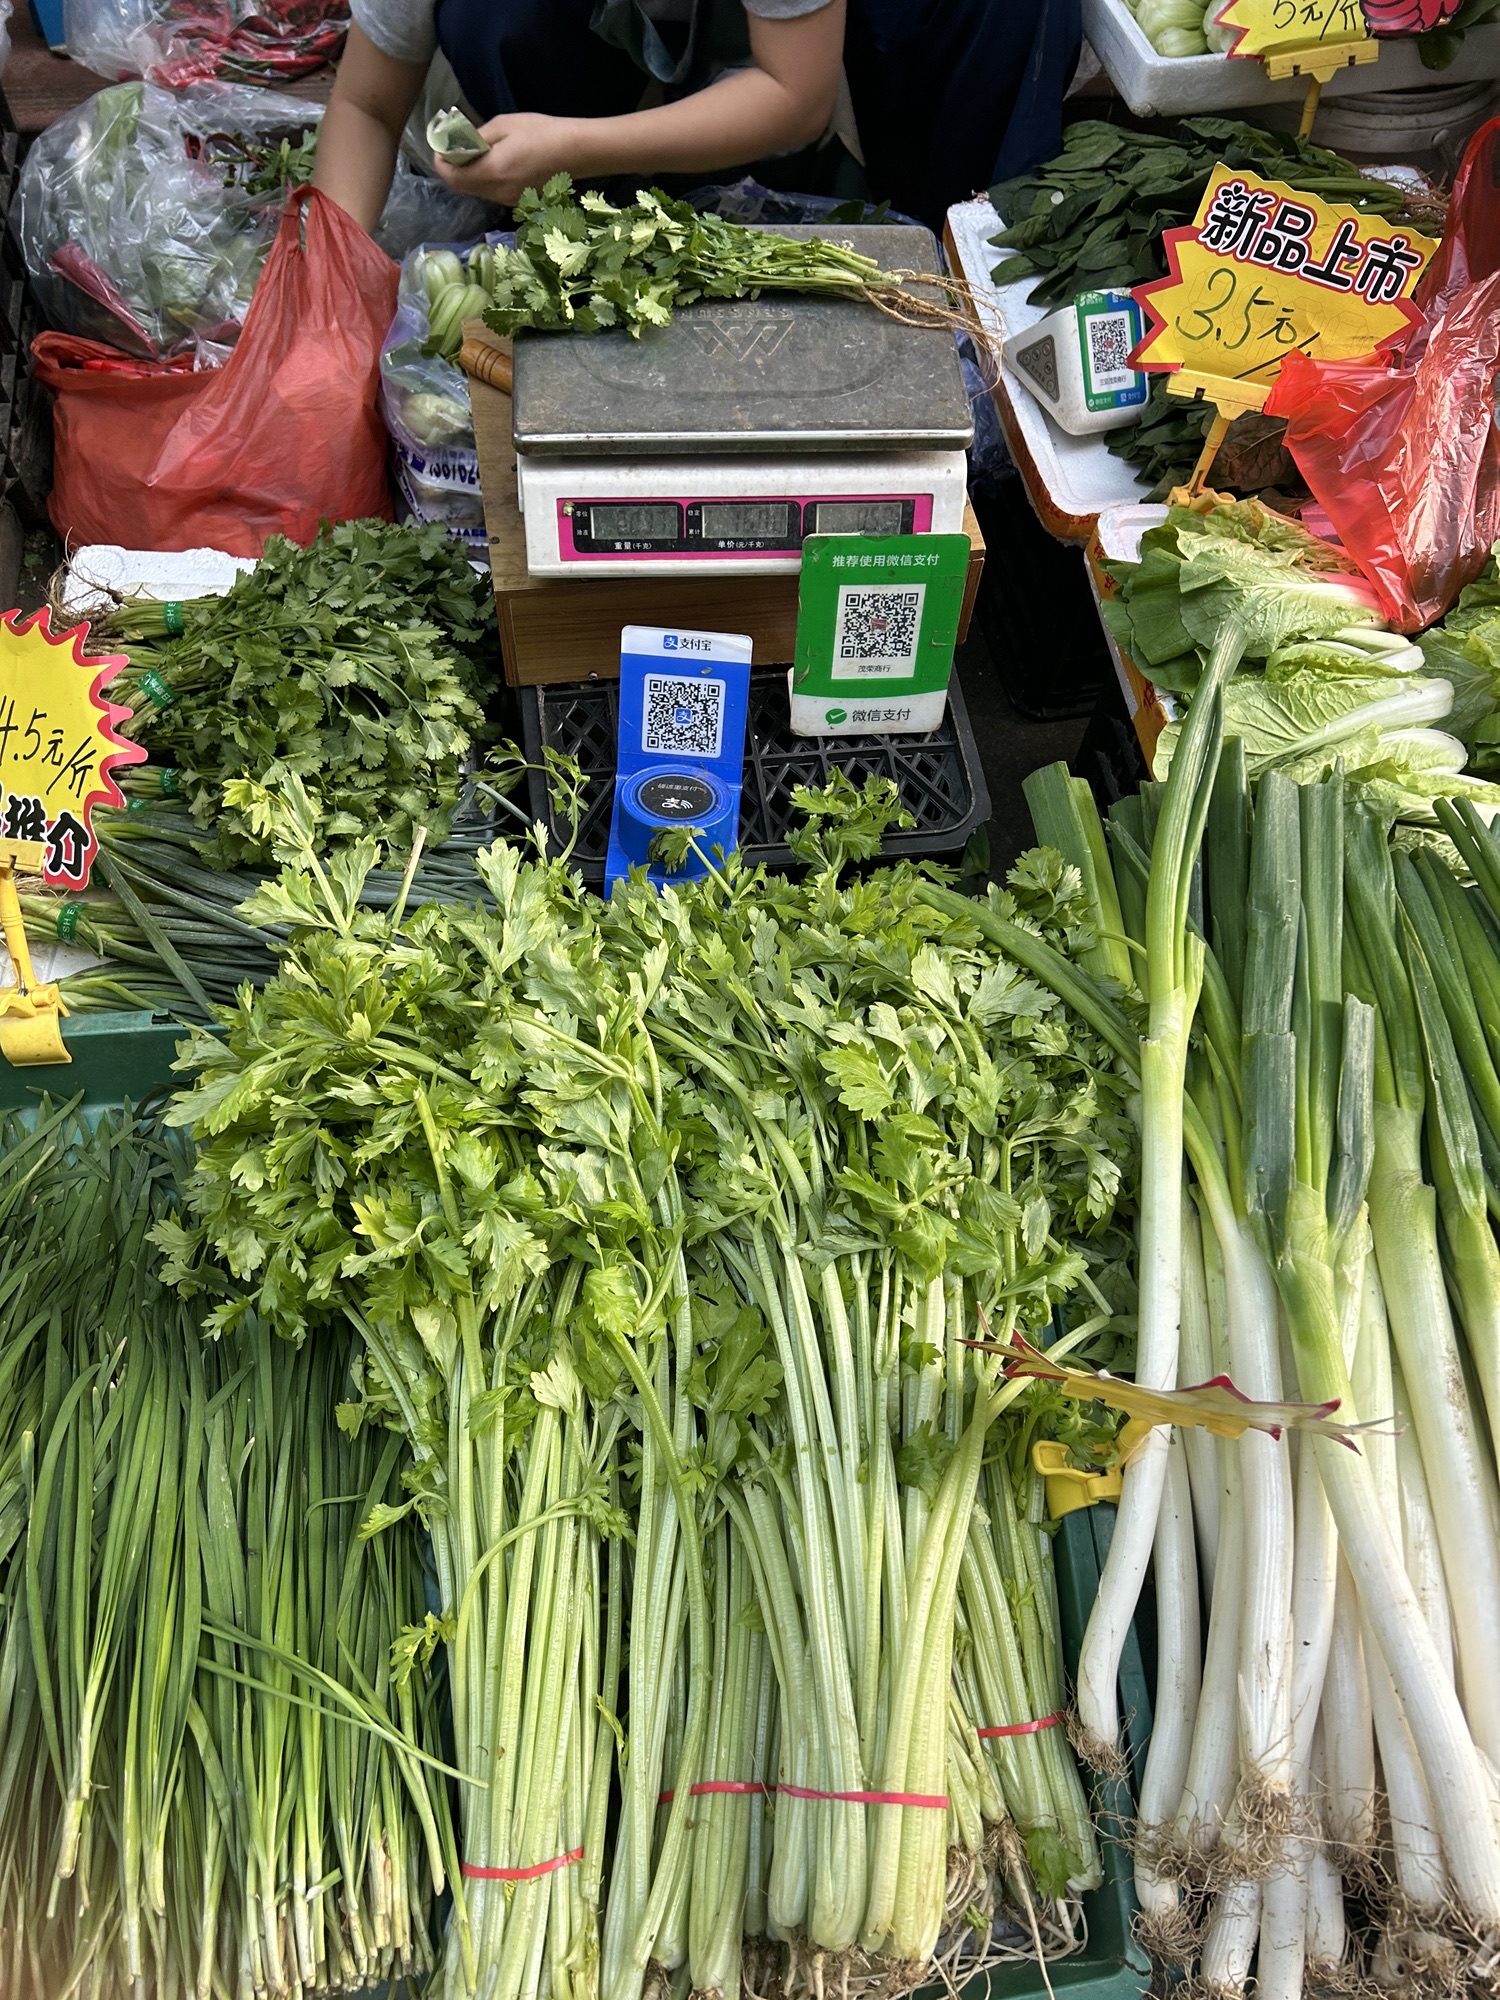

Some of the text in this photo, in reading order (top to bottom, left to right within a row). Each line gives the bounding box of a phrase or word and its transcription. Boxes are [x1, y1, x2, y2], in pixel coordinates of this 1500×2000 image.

[1200, 183, 1420, 301] 新品上市
[1175, 267, 1321, 379] 3.5元/
[832, 553, 940, 568] 推荐使用微信支付
[679, 637, 712, 651] 支付宝
[852, 708, 912, 723] 微信支付
[0, 785, 91, 878] 推介
